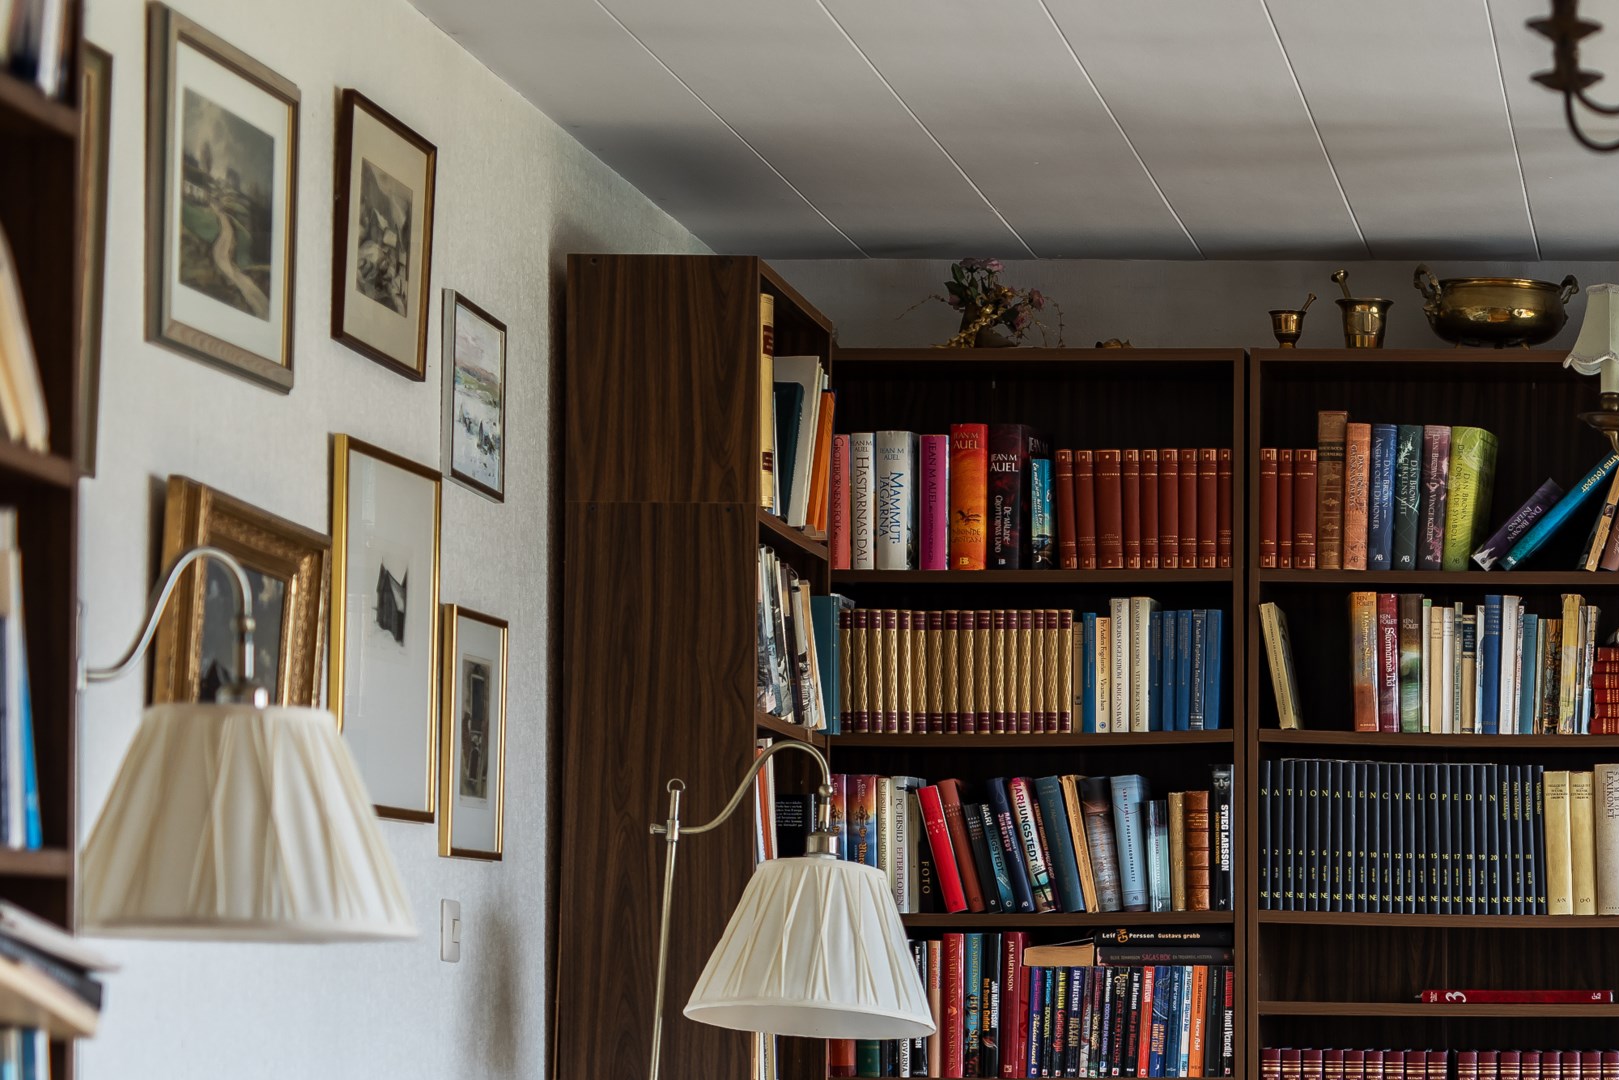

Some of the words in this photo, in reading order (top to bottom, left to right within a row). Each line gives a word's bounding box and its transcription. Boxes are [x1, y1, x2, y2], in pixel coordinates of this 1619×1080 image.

[928, 442, 937, 464] JEAN
[928, 466, 937, 478] M
[1581, 469, 1605, 493] fotspår
[928, 480, 937, 504] AUEL
[1373, 491, 1381, 529] DEMONER
[856, 538, 868, 565] DAL
[1385, 674, 1395, 687] Tid
[896, 798, 904, 808] PC
[1606, 771, 1615, 819] LEXIKONET
[895, 811, 905, 843] JERSILD
[1221, 805, 1229, 829] STIEG
[896, 847, 904, 870] EFTER
[1221, 832, 1229, 871] LARSSON
[896, 872, 905, 907] FLODEN
[921, 861, 930, 894] FOTO
[990, 994, 998, 1028] MÅRTENSON
